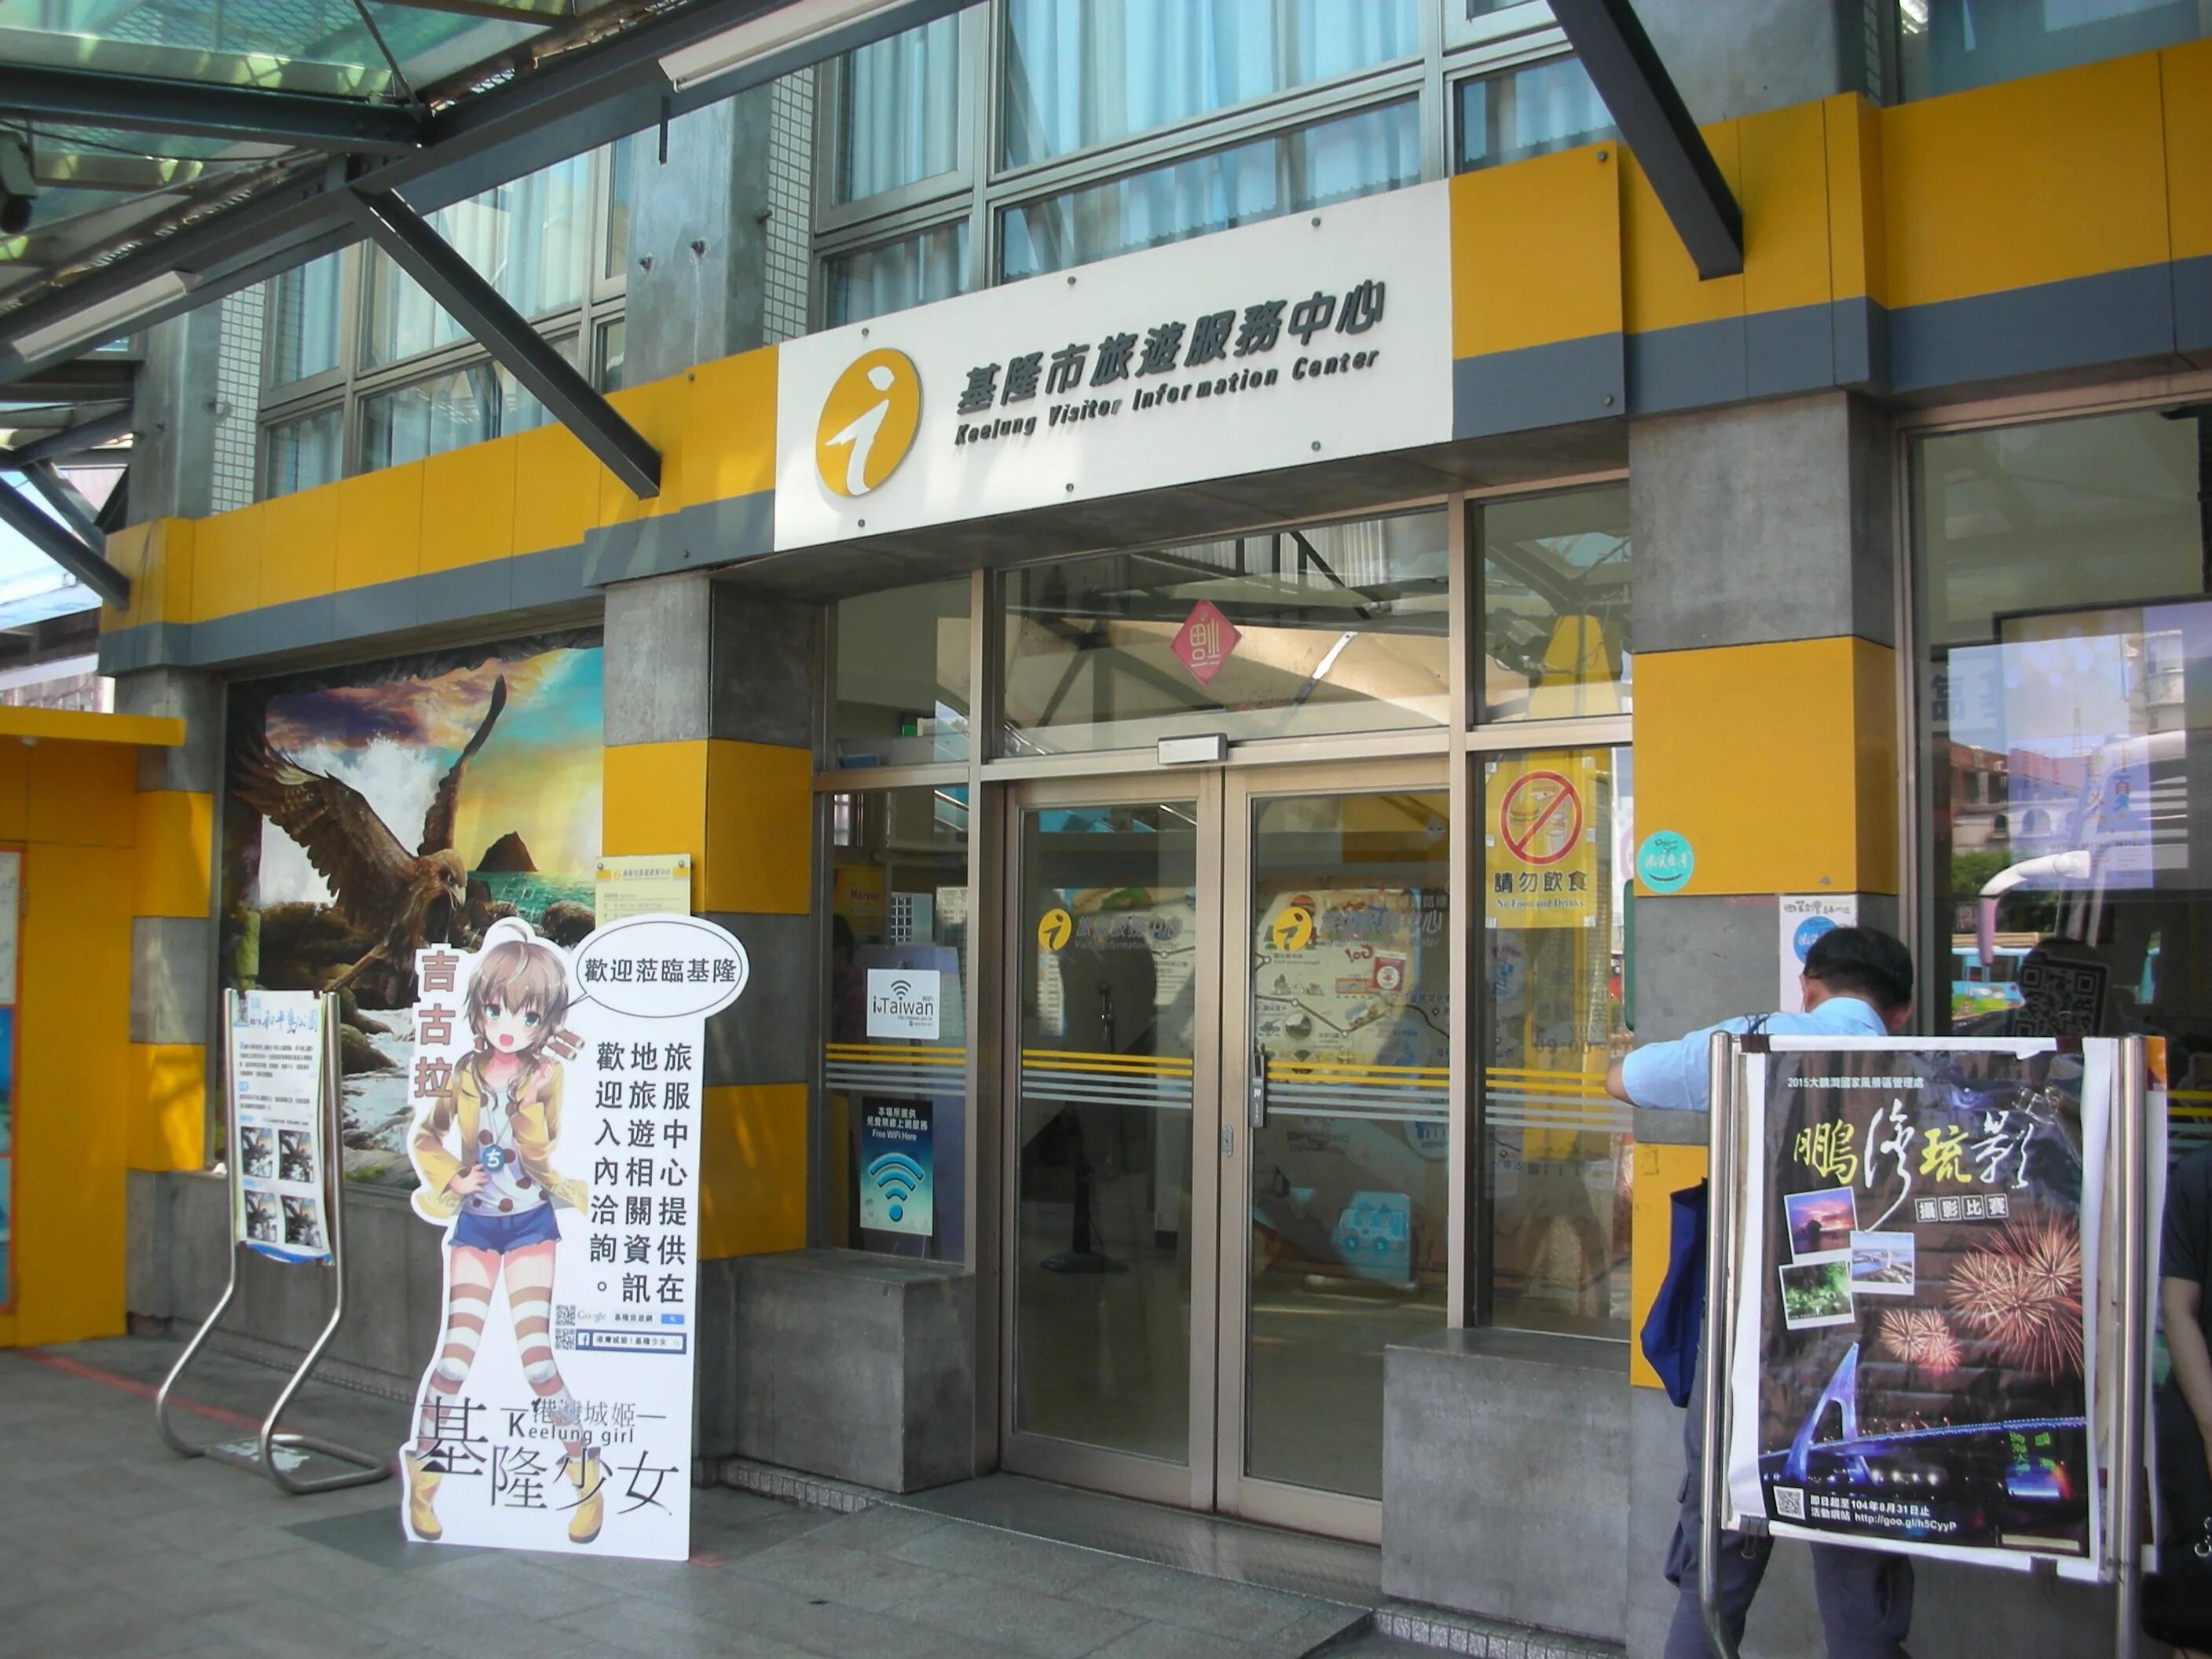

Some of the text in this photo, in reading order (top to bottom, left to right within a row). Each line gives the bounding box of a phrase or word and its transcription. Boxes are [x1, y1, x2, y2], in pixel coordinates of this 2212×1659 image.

[957, 278, 1385, 416] 基隆市旅遊服務中心
[954, 350, 1380, 446] Keelung Visitor Information Center
[1494, 870, 1588, 893] 請勿飲食
[1497, 898, 1584, 908] No Food and Drinks
[584, 958, 737, 983] 歡迎蒞臨基隆
[414, 950, 459, 1098] 吉古拉
[872, 1128, 886, 1139] Free
[902, 1131, 917, 1141] Here
[589, 1042, 625, 1292] 歡迎入內洽詢。
[622, 1042, 658, 1304] 地旅遊相關資訊
[656, 1042, 693, 1304] 旅服中心提供在
[1918, 1196, 2006, 1220] 攝影比賽
[577, 1309, 606, 1324] Google
[509, 1412, 634, 1447] Keelung girl
[416, 1396, 680, 1517] 基隆少女
[1810, 1494, 1930, 1518] 即日起至104年8月31日止
[1811, 1506, 1851, 1522] 活動網站
